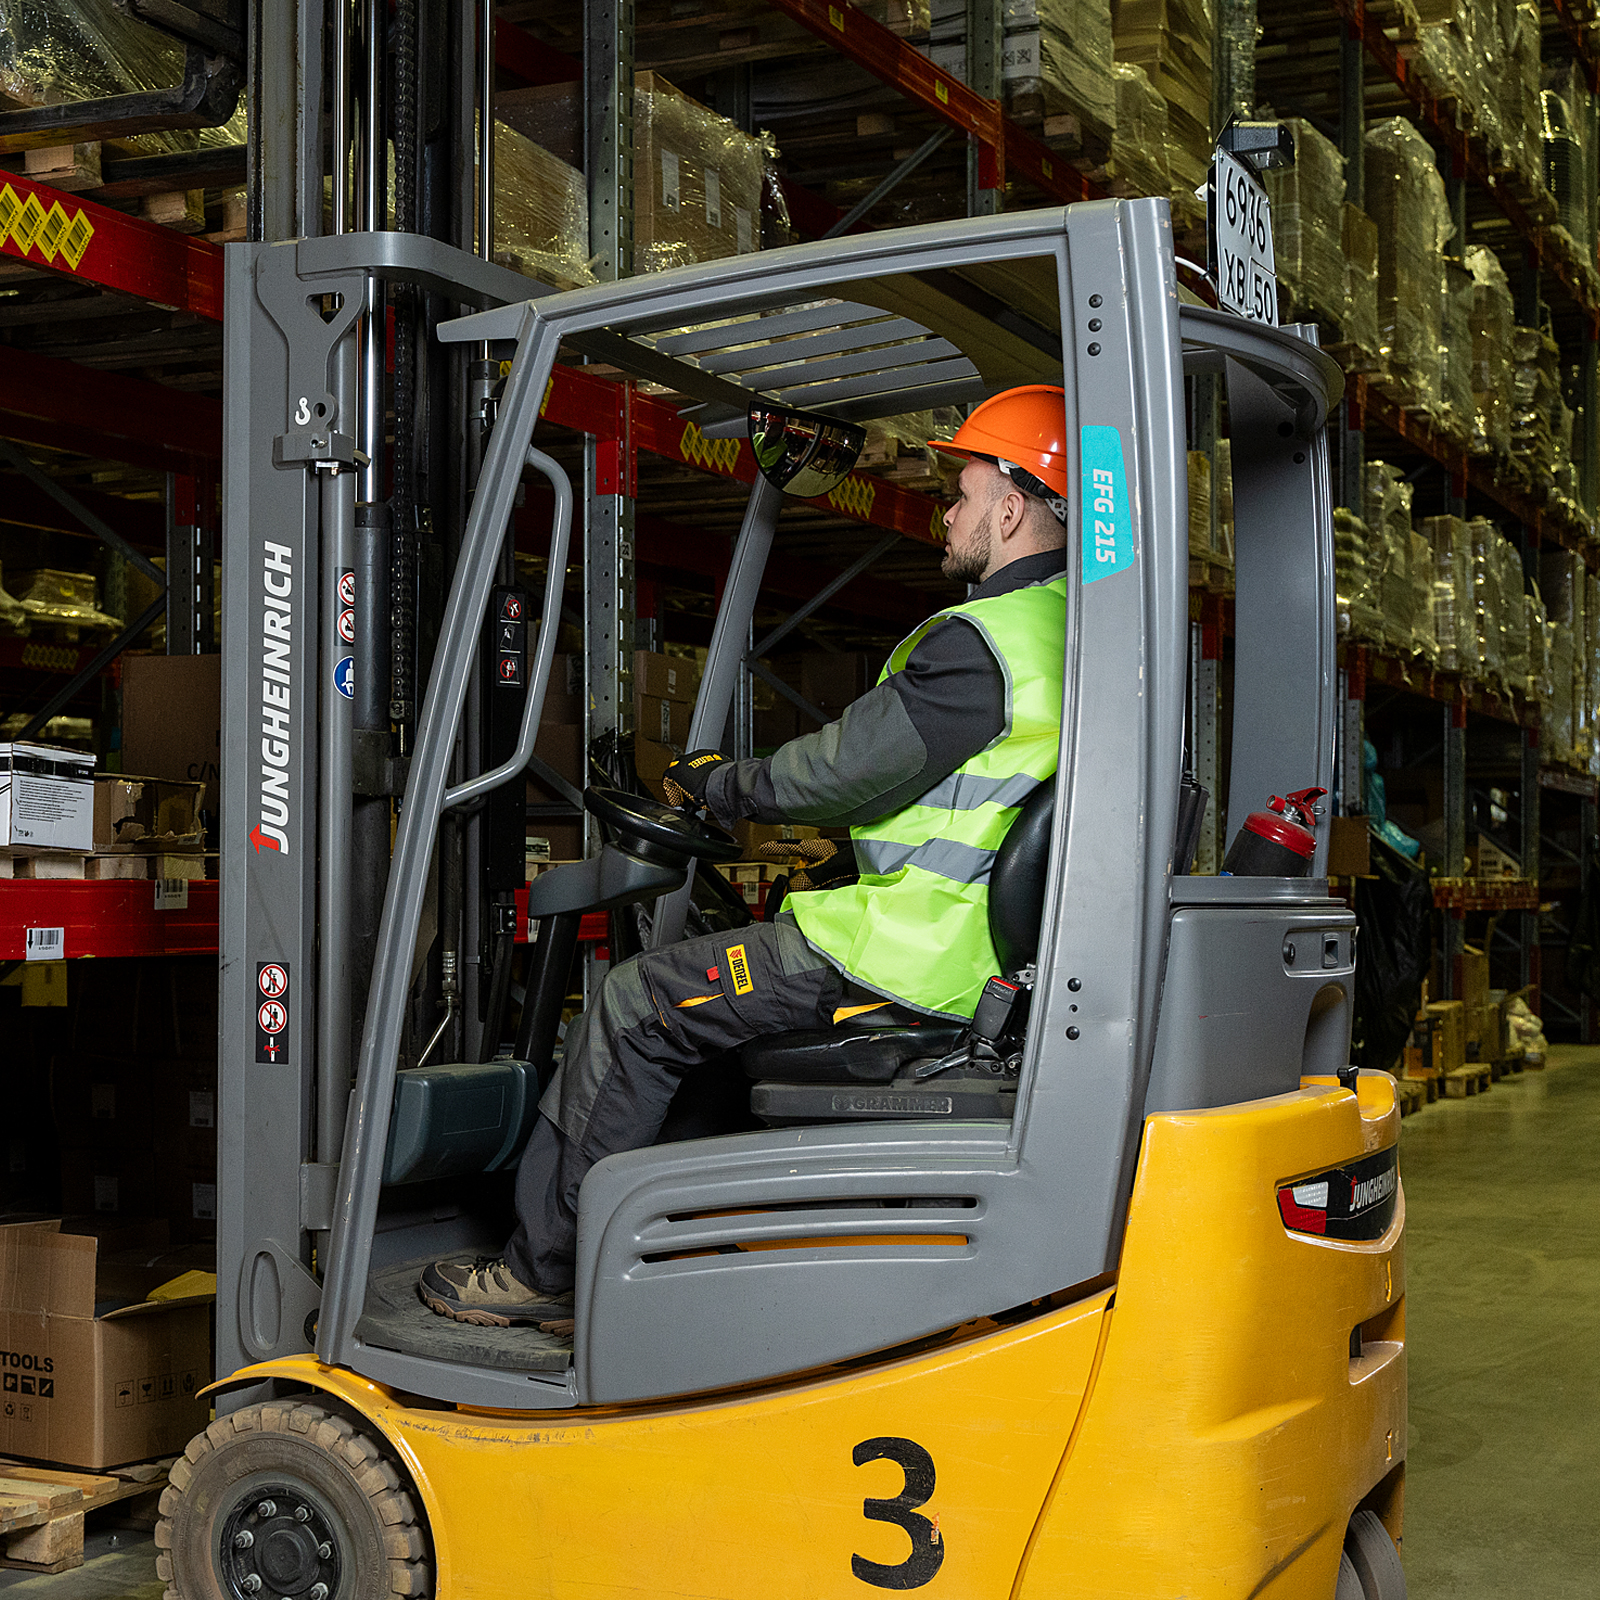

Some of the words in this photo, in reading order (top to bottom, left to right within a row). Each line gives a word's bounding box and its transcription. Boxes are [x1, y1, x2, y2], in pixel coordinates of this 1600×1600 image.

[1225, 167, 1266, 254] 6936
[1254, 273, 1273, 325] 50
[1093, 469, 1115, 514] EFG
[1095, 520, 1116, 564] 215
[260, 540, 293, 855] JUNGHEINRICH
[732, 958, 749, 991] DENZEL
[855, 1096, 949, 1112] GRAMMER
[0, 1352, 54, 1373] TOOLS
[851, 1437, 945, 1590] 3
